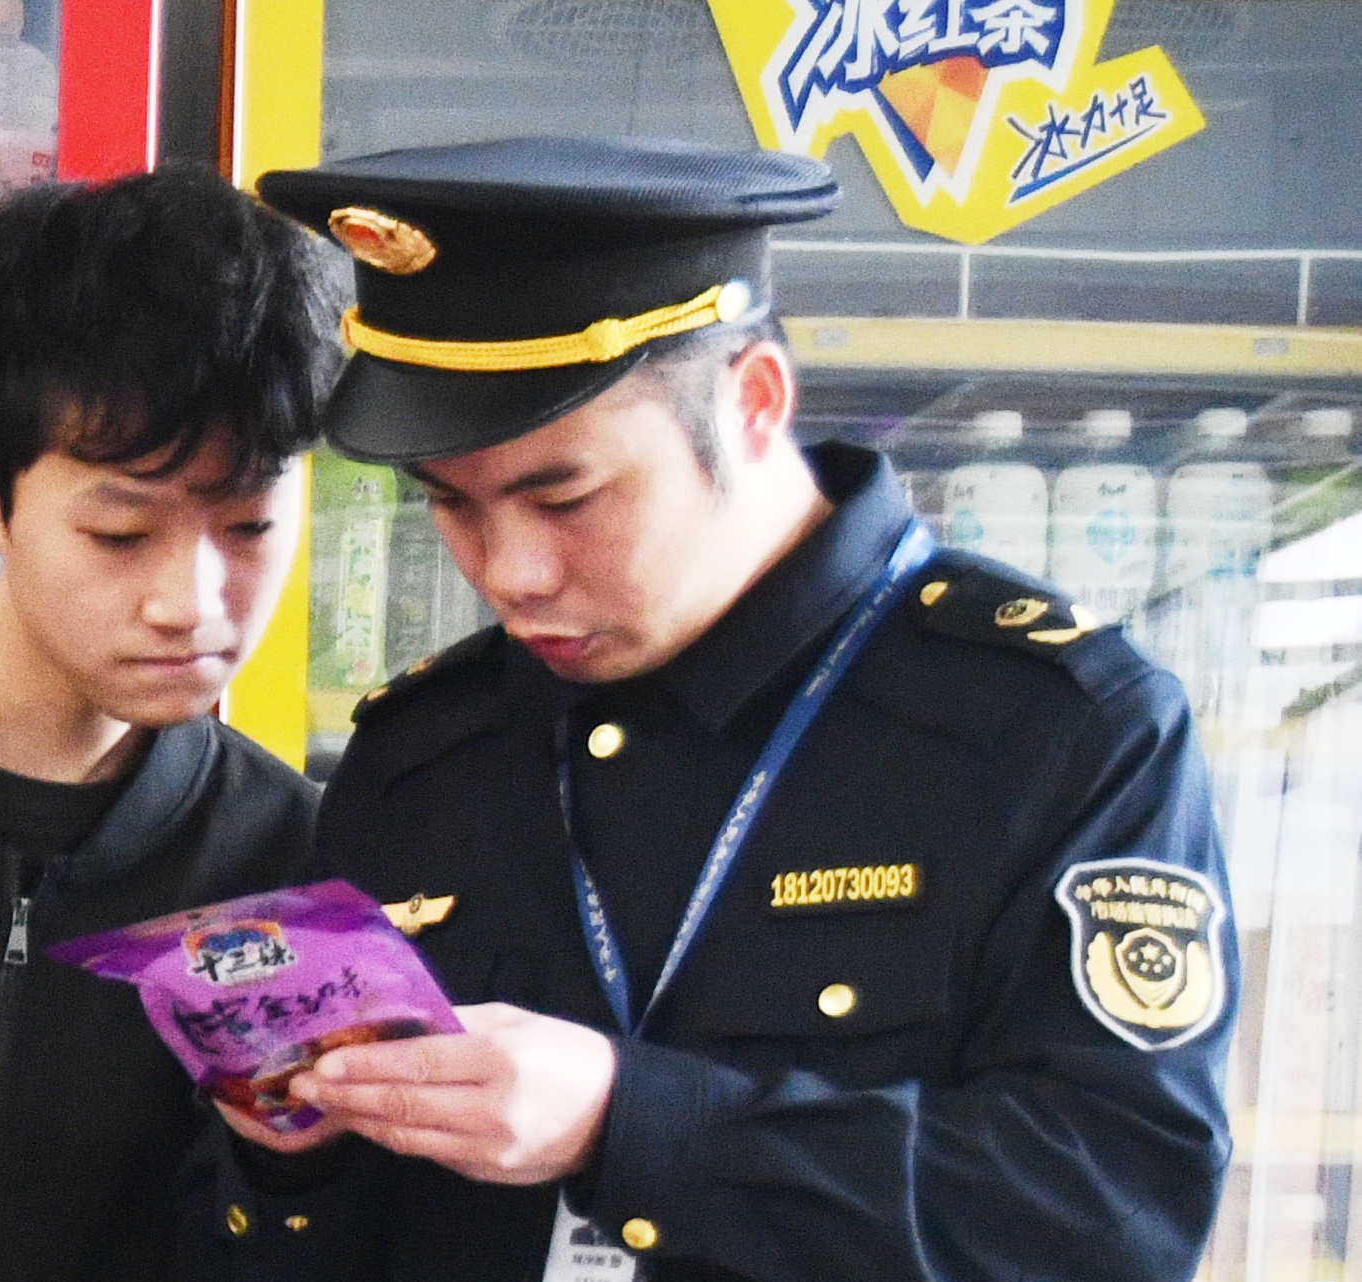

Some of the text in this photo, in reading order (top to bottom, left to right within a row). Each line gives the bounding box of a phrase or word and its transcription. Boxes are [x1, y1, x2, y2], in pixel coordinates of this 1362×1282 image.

[1007, 76, 1166, 180] 冰力十足
[771, 863, 915, 908] 18120730093
